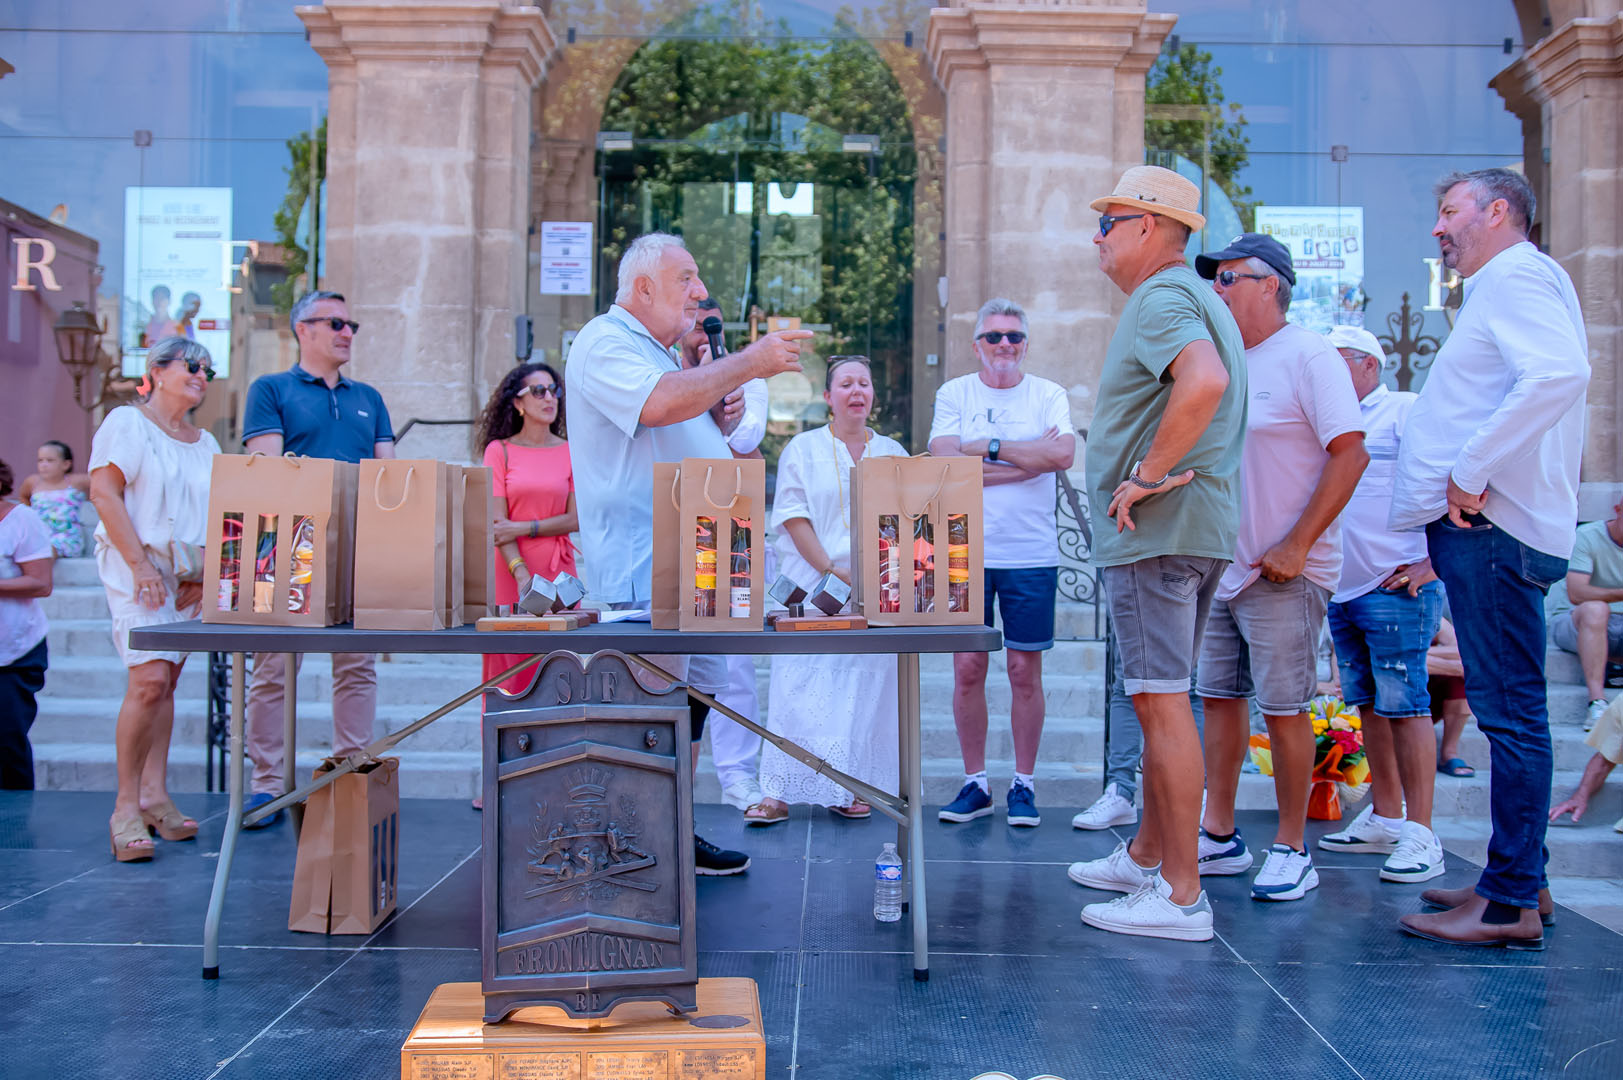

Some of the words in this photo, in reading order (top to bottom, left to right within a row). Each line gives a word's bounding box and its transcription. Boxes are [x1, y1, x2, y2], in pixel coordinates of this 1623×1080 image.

[11, 237, 62, 291] R
[216, 240, 259, 294] F
[513, 931, 663, 974] FRONTIGNAN
